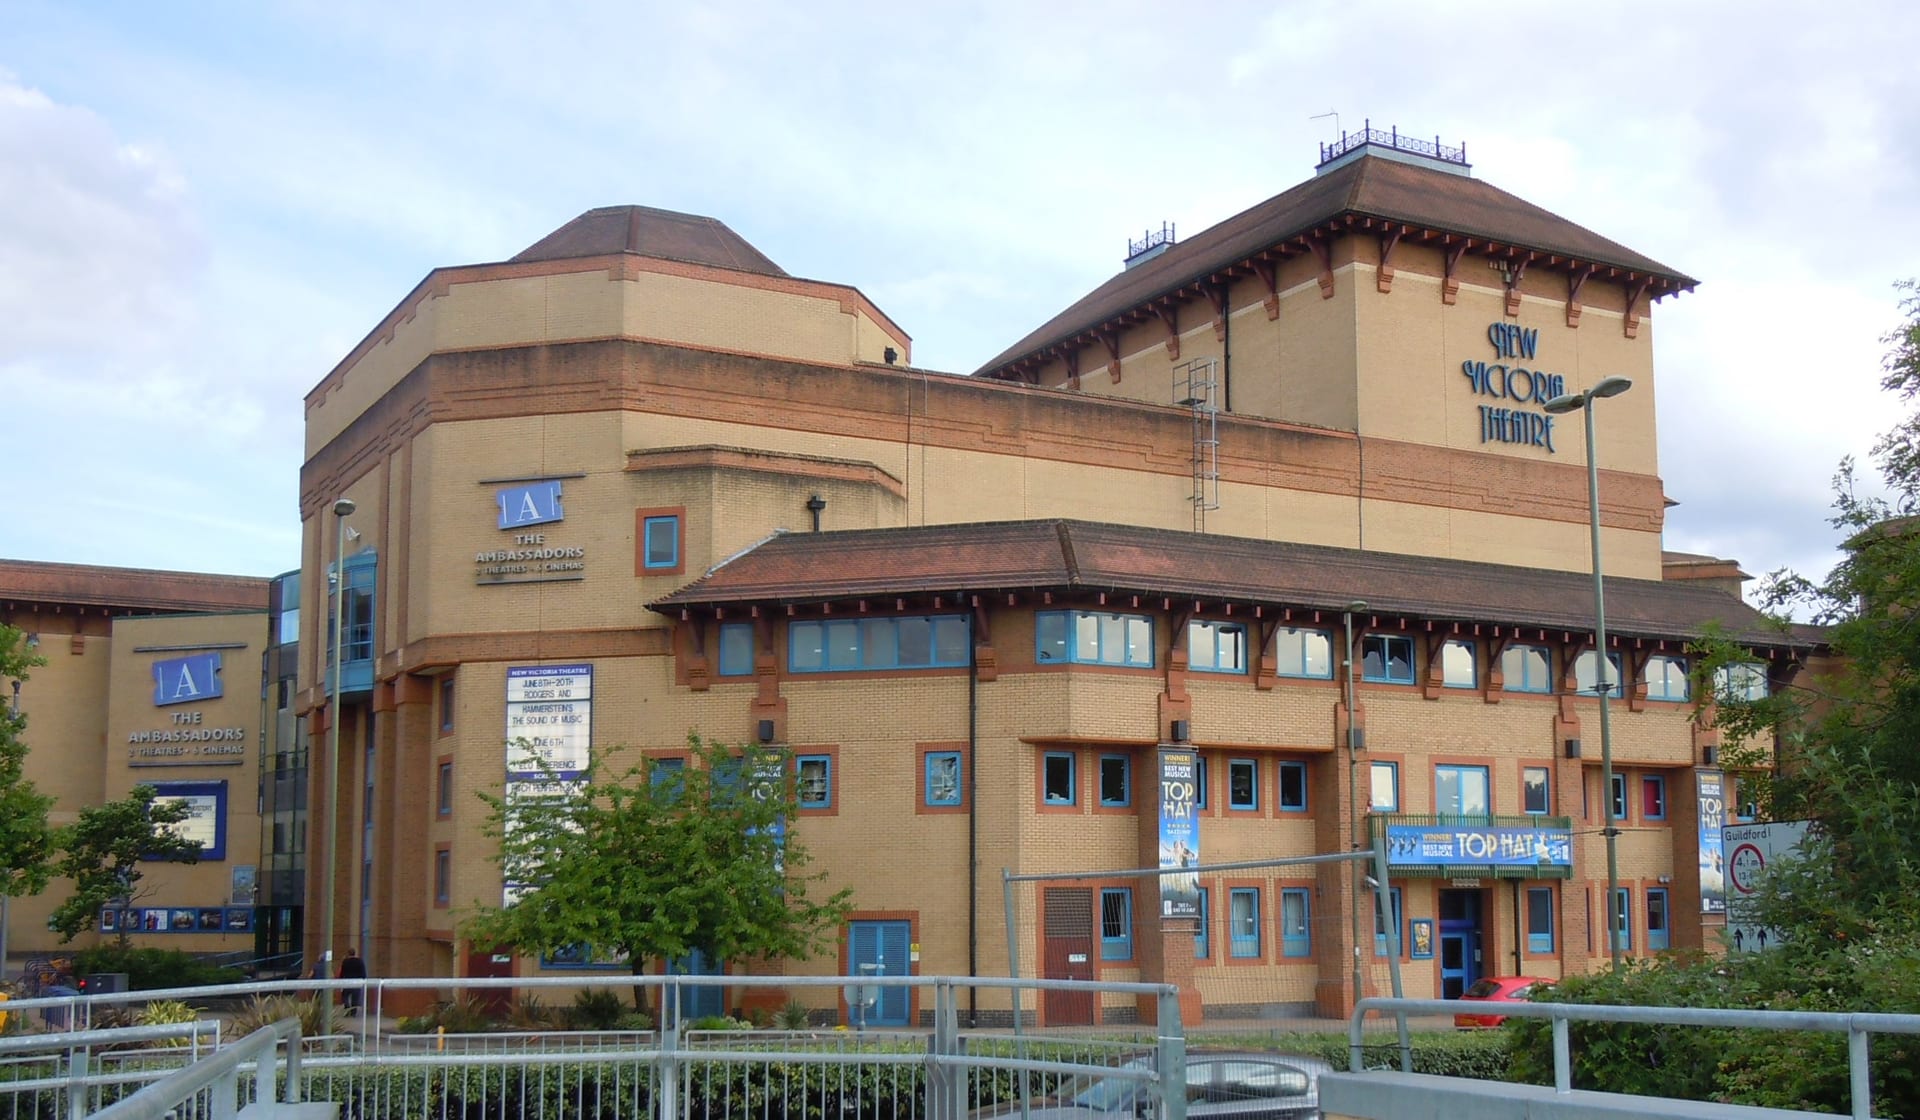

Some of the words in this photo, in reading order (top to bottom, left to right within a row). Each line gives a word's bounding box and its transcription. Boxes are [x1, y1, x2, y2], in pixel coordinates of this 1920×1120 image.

[1488, 322, 1538, 360] NEW
[1462, 360, 1565, 405] VICTORIA
[1478, 404, 1555, 454] THEATRE
[515, 534, 545, 545] THE
[475, 547, 585, 563] AMBASSADORS
[484, 565, 528, 574] THEATRES
[544, 562, 585, 572] CINEMAS
[524, 690, 555, 699] RODGERS
[558, 690, 572, 698] AND
[522, 704, 574, 713] HAMMERSTEIN'S
[171, 712, 202, 725] THE
[512, 717, 525, 725] THE
[526, 716, 548, 725] SOUND
[550, 716, 559, 724] OF
[561, 715, 583, 723] MUSIC
[128, 728, 244, 743] AMBASSADORS
[138, 747, 183, 757] THEATRES
[202, 746, 244, 755] CINEMAS
[540, 750, 552, 758] THE
[1161, 781, 1194, 801] TOP
[1163, 801, 1193, 819] HAT
[1699, 798, 1722, 814] TOP
[1701, 814, 1722, 830] HAT
[1725, 829, 1767, 841] Guildford
[1456, 832, 1498, 858] TOP
[1501, 833, 1533, 858] HAT
